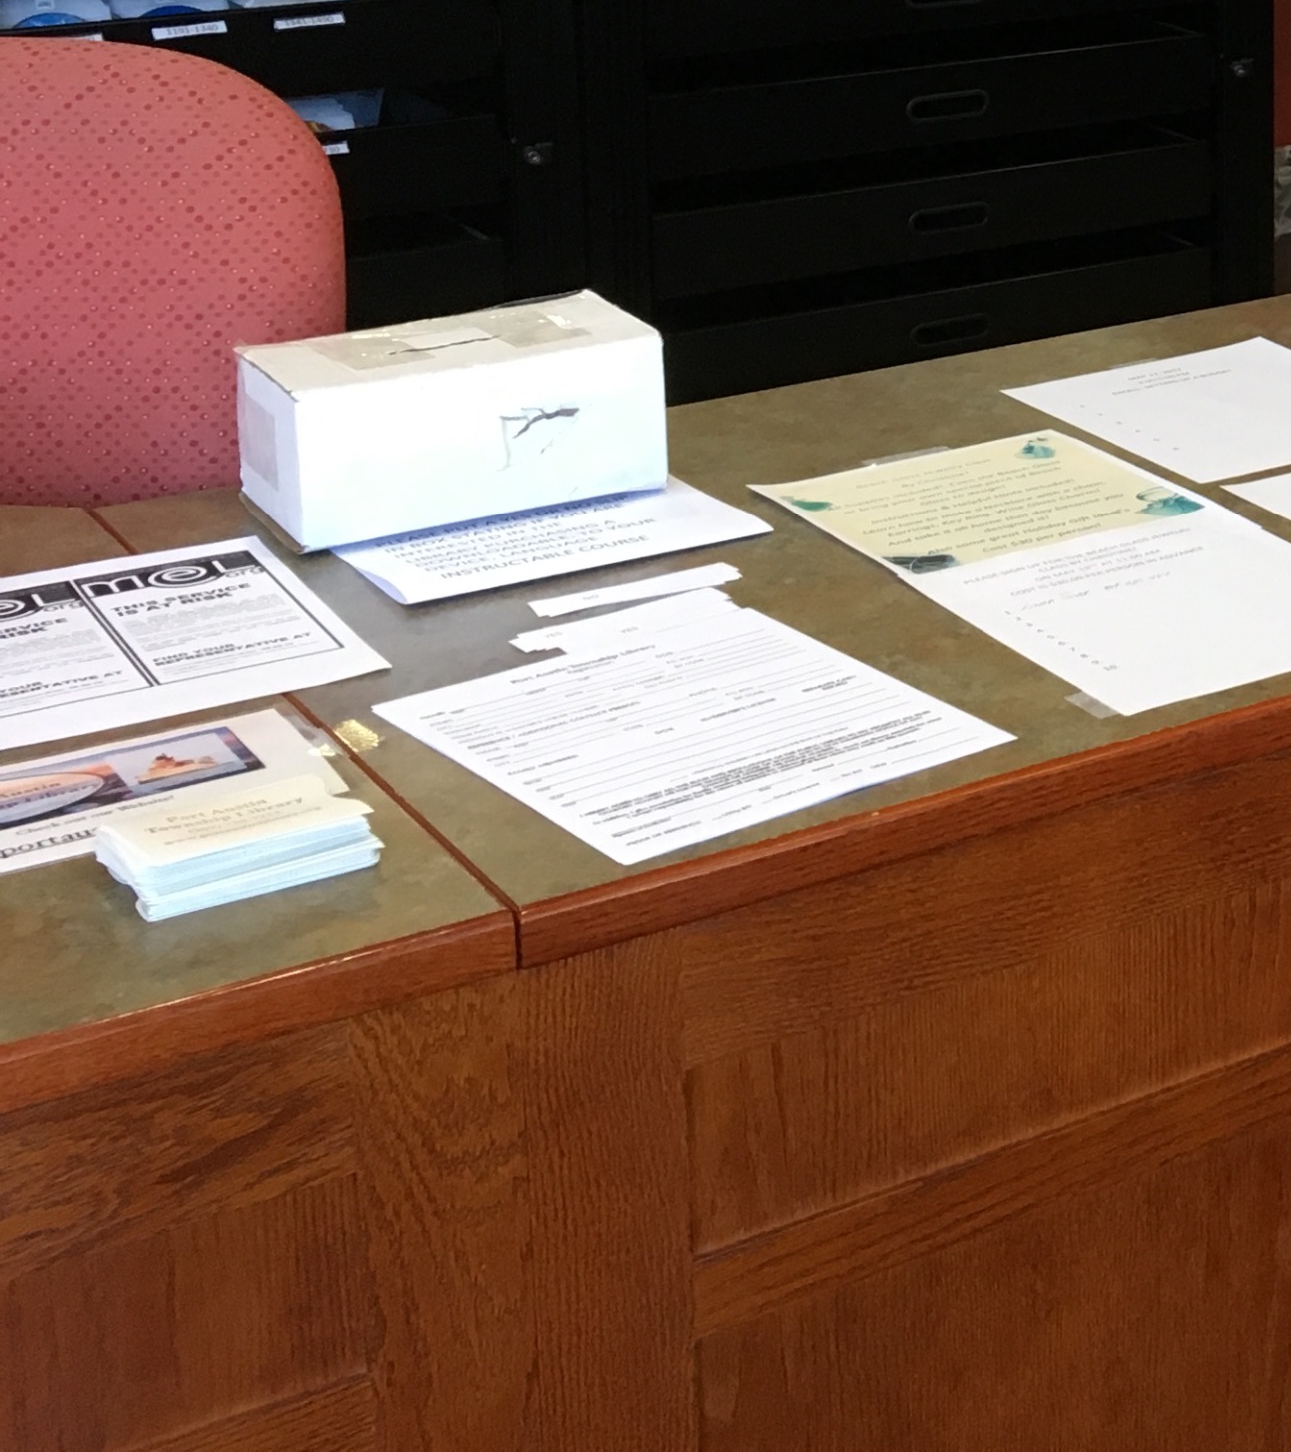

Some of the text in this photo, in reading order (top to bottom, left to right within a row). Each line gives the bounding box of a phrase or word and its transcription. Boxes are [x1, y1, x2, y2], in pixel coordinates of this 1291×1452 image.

[410, 537, 444, 548] BOX
[452, 520, 526, 538] STATING
[610, 519, 654, 530] YOUR
[396, 535, 500, 557] INTERESTED
[532, 522, 559, 530] THE
[406, 547, 476, 563] LIBRARY
[485, 524, 598, 547] PURCHASING
[501, 537, 596, 557] LANGUAGE
[442, 536, 645, 577] INSTRUCTABLE COURSE
[114, 584, 248, 611] THIS SERVICE
[147, 603, 169, 611] AT
[181, 593, 230, 604] RISK
[153, 644, 234, 662] FIND YOUR
[156, 638, 286, 665] REPRESENTATIVE
[104, 670, 122, 678] AT
[145, 816, 231, 834] Township
[236, 797, 303, 818] Library
[166, 812, 204, 823] Port
[212, 799, 267, 815] Austin
[16, 821, 60, 836] Check
[64, 816, 87, 825] out
